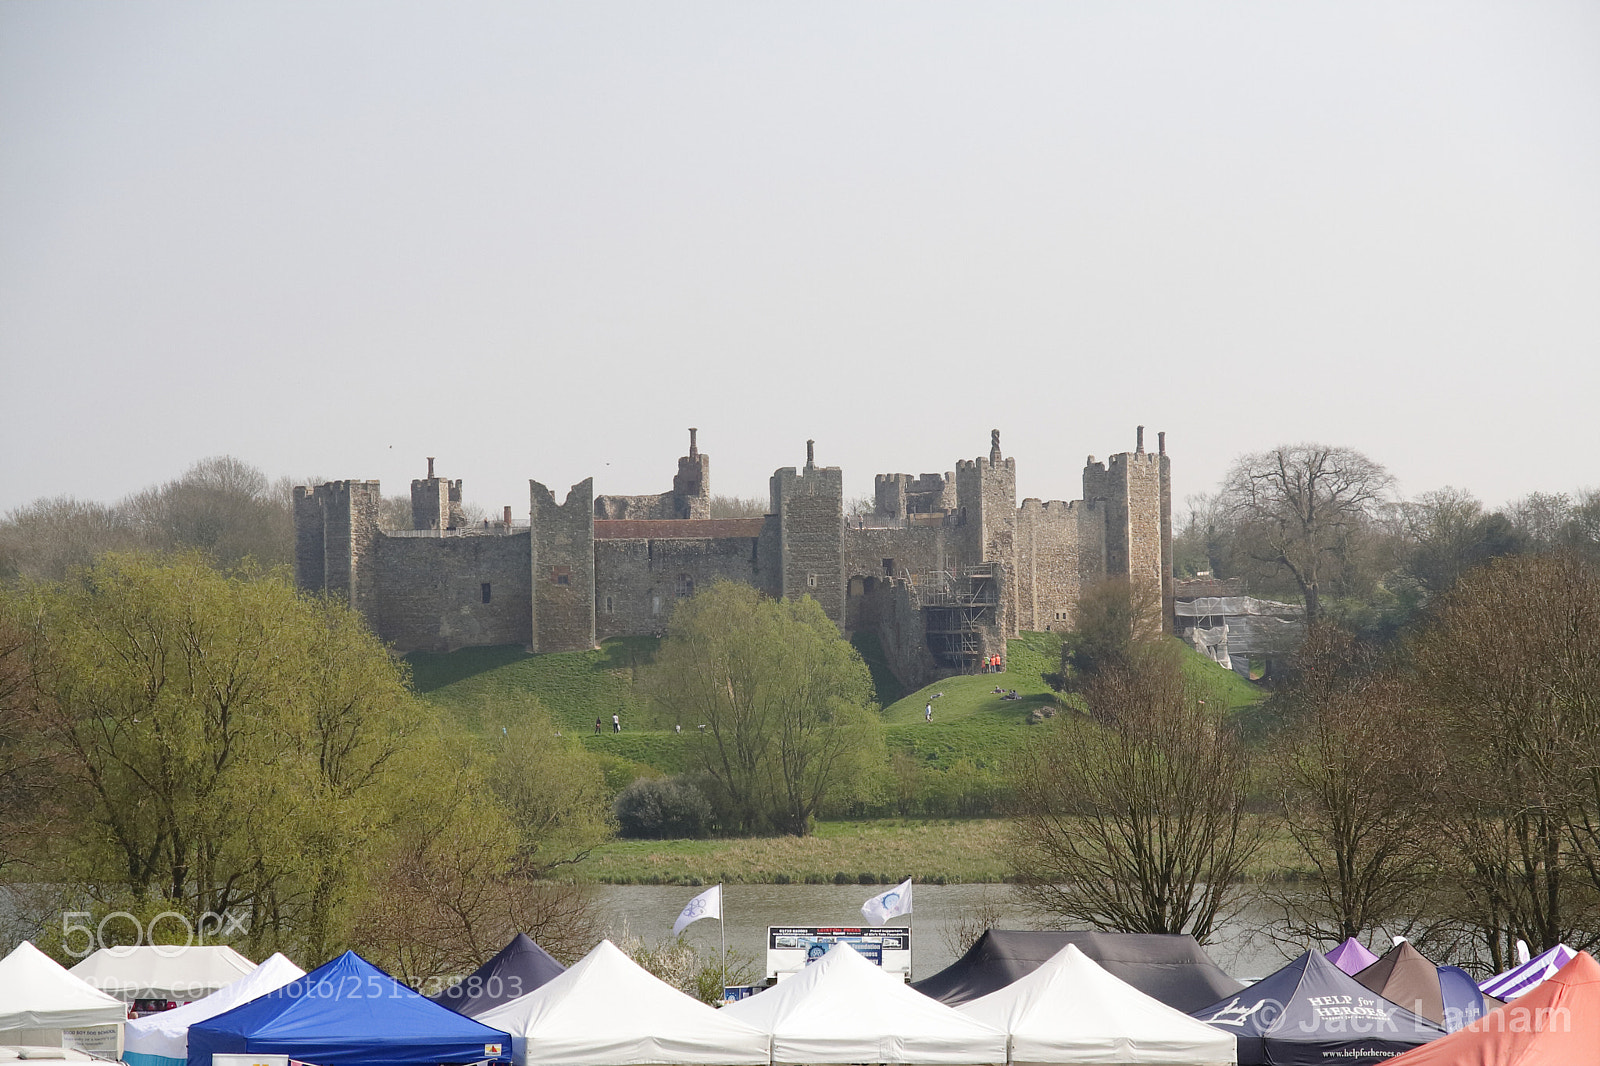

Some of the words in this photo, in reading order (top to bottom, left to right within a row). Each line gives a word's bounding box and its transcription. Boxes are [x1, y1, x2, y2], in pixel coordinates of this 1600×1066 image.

[1307, 995, 1352, 1006] HELP
[1358, 997, 1375, 1007] for
[1315, 1006, 1387, 1017] HEROES
